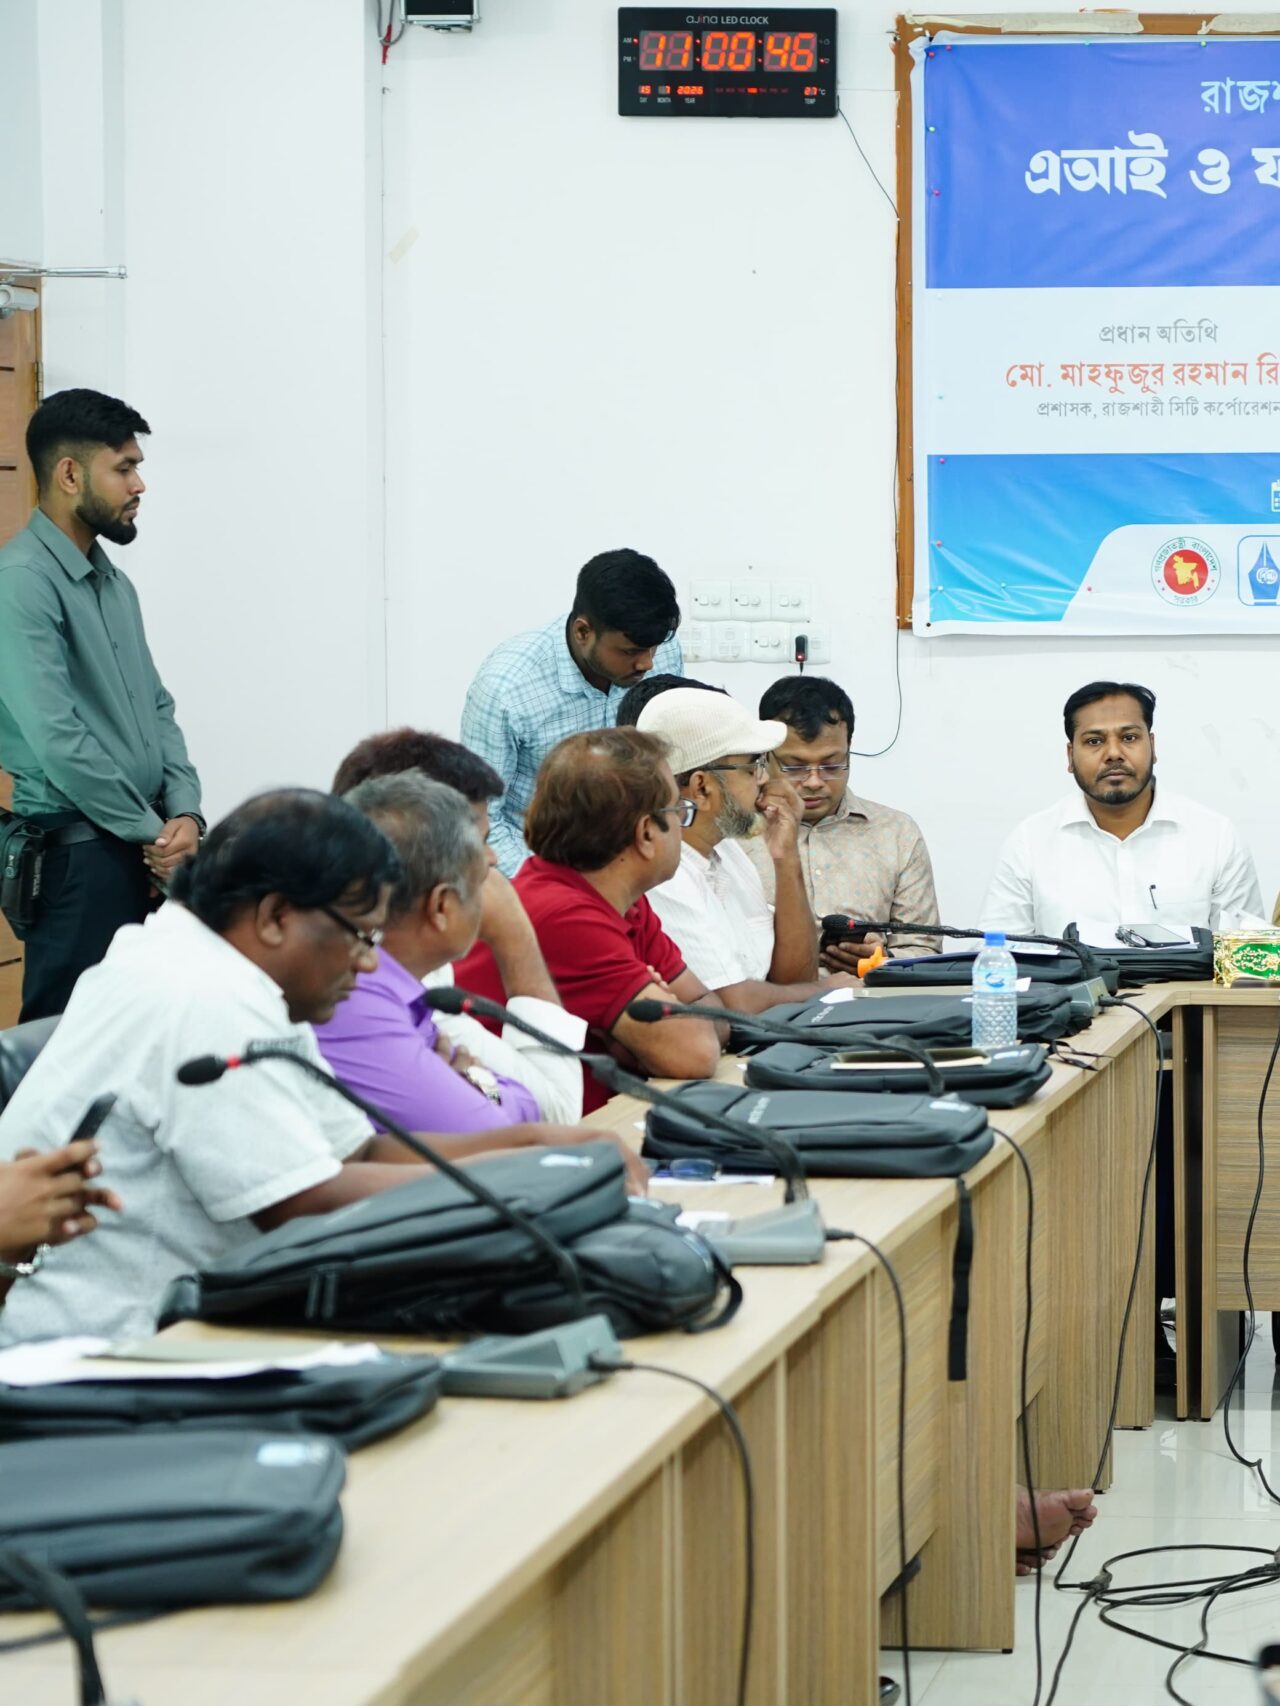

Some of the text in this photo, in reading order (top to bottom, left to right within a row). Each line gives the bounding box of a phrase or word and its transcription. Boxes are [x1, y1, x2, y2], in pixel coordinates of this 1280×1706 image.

[721, 16, 738, 24] LED
[740, 16, 769, 24] CLOCK
[1025, 130, 1168, 199] এআই
[1189, 148, 1232, 195] ও
[1099, 318, 1219, 344] প্রধান অতিথি
[1006, 360, 1052, 388] মো.
[1060, 360, 1165, 395] মাহফুজুর
[1172, 360, 1249, 386] রহমান
[1037, 399, 1098, 420] প্রশাসক,
[1102, 396, 1164, 417] রাজশাহী
[1169, 396, 1200, 417] সিটি
